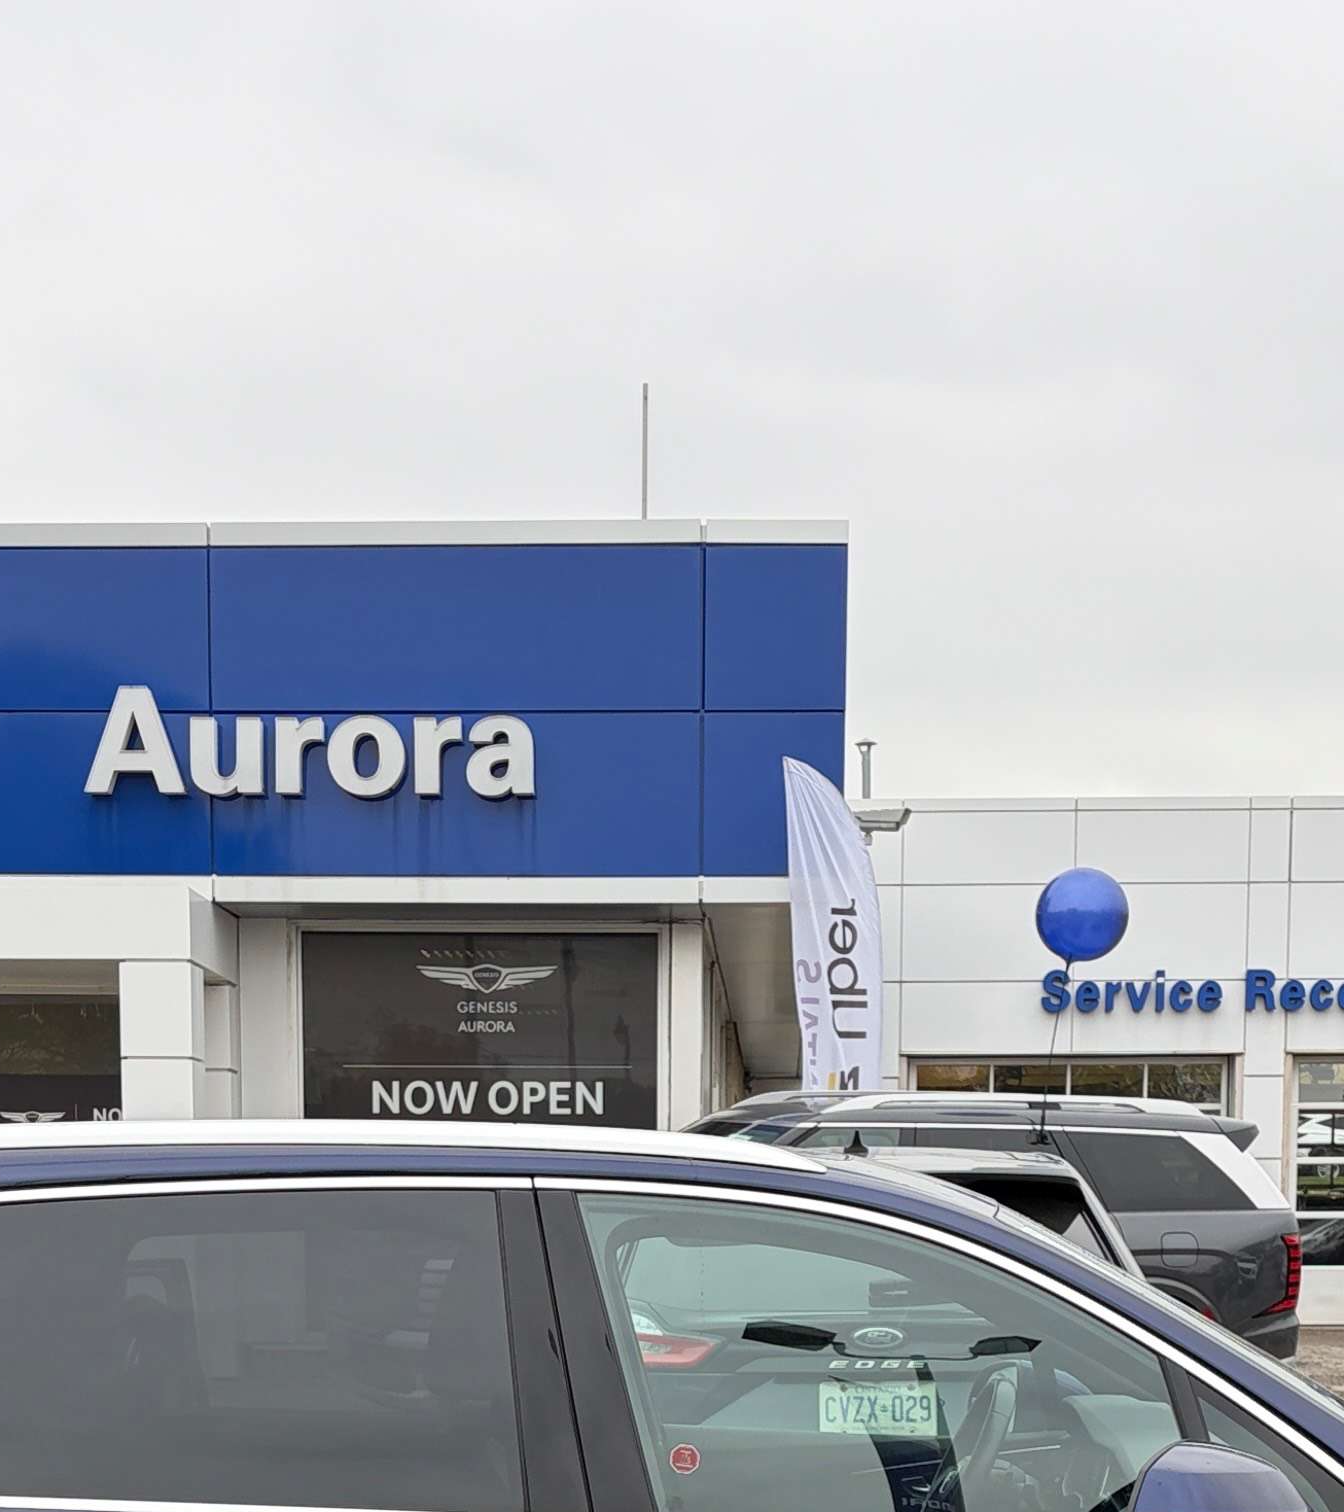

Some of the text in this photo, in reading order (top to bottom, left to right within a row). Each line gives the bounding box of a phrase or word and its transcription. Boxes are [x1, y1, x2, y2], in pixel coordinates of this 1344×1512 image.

[83, 684, 536, 799] Aurora
[1040, 969, 1224, 1014] Service
[457, 1001, 518, 1014] GENESIS
[457, 1020, 516, 1033] AURORA
[371, 1080, 605, 1116] NOW OPEN
[828, 1360, 926, 1369] EDGE
